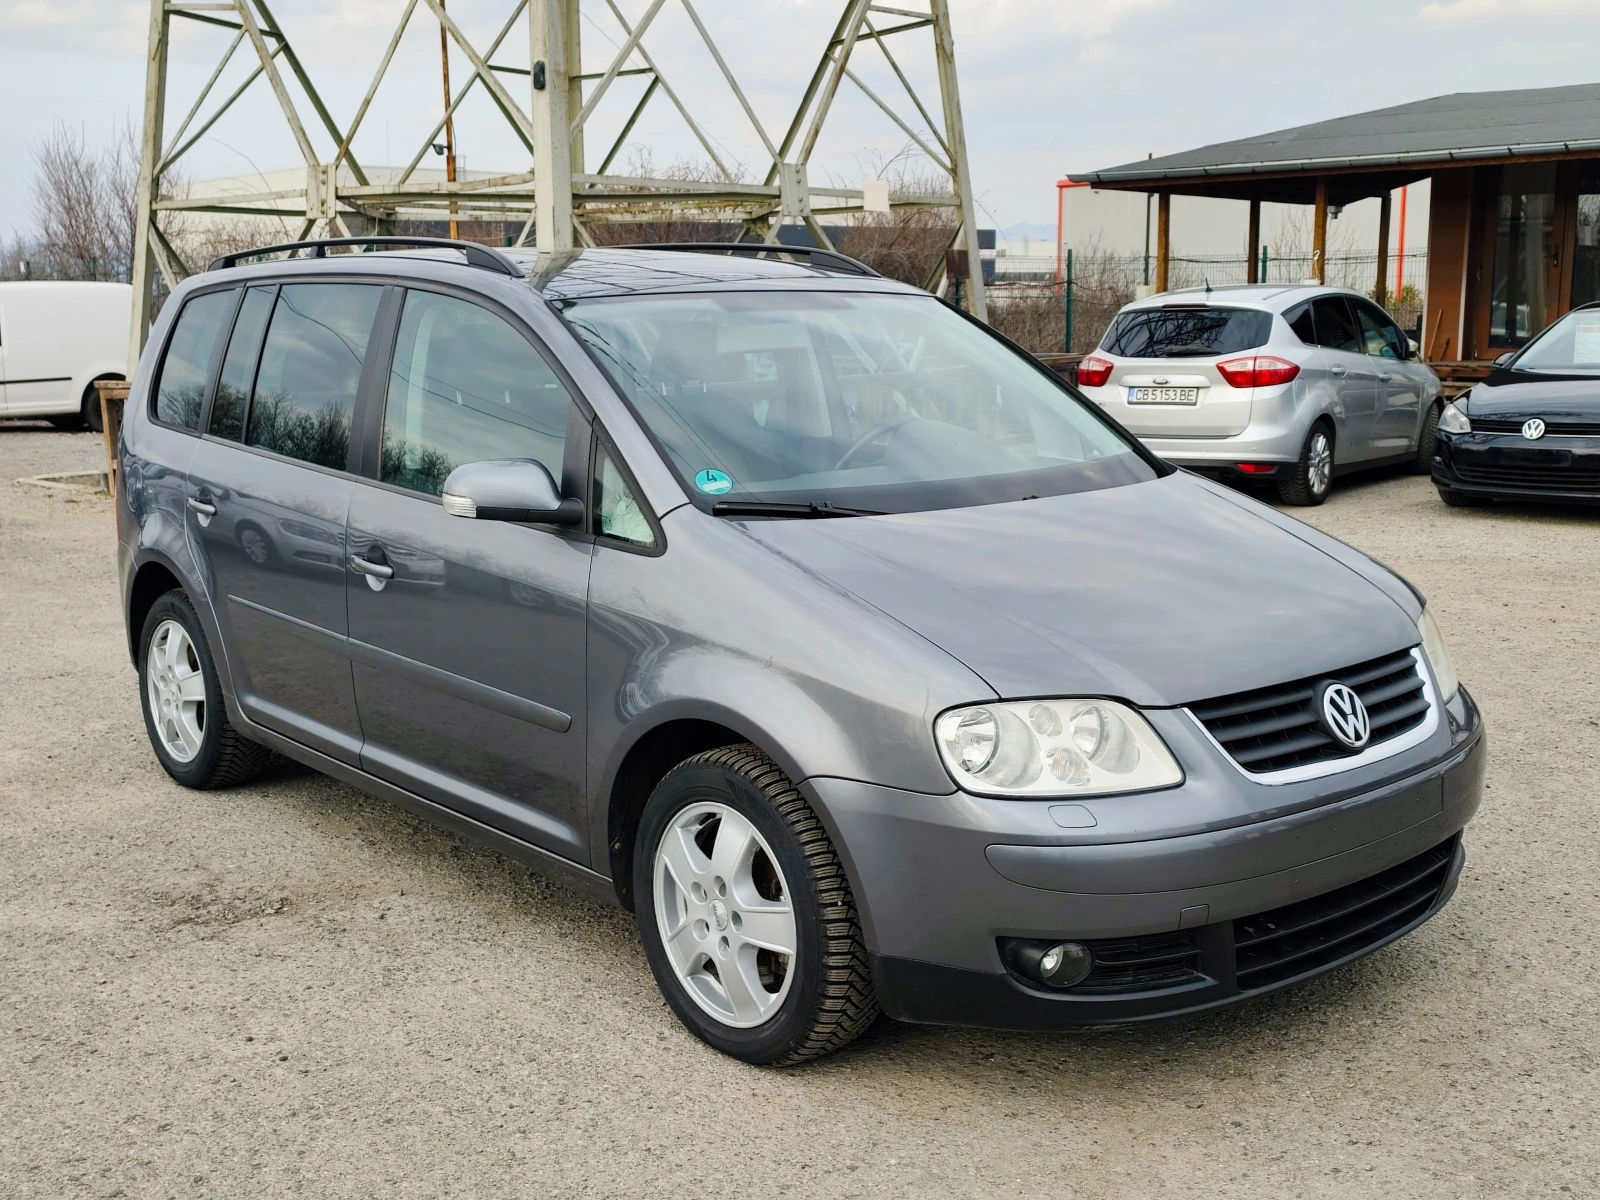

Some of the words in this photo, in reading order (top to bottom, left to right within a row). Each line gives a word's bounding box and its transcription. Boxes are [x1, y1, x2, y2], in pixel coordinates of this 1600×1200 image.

[1135, 389, 1149, 401] CB
[1150, 389, 1178, 401] 5153
[1179, 389, 1195, 401] BE
[706, 470, 718, 482] 4
[1324, 684, 1369, 747] VW
